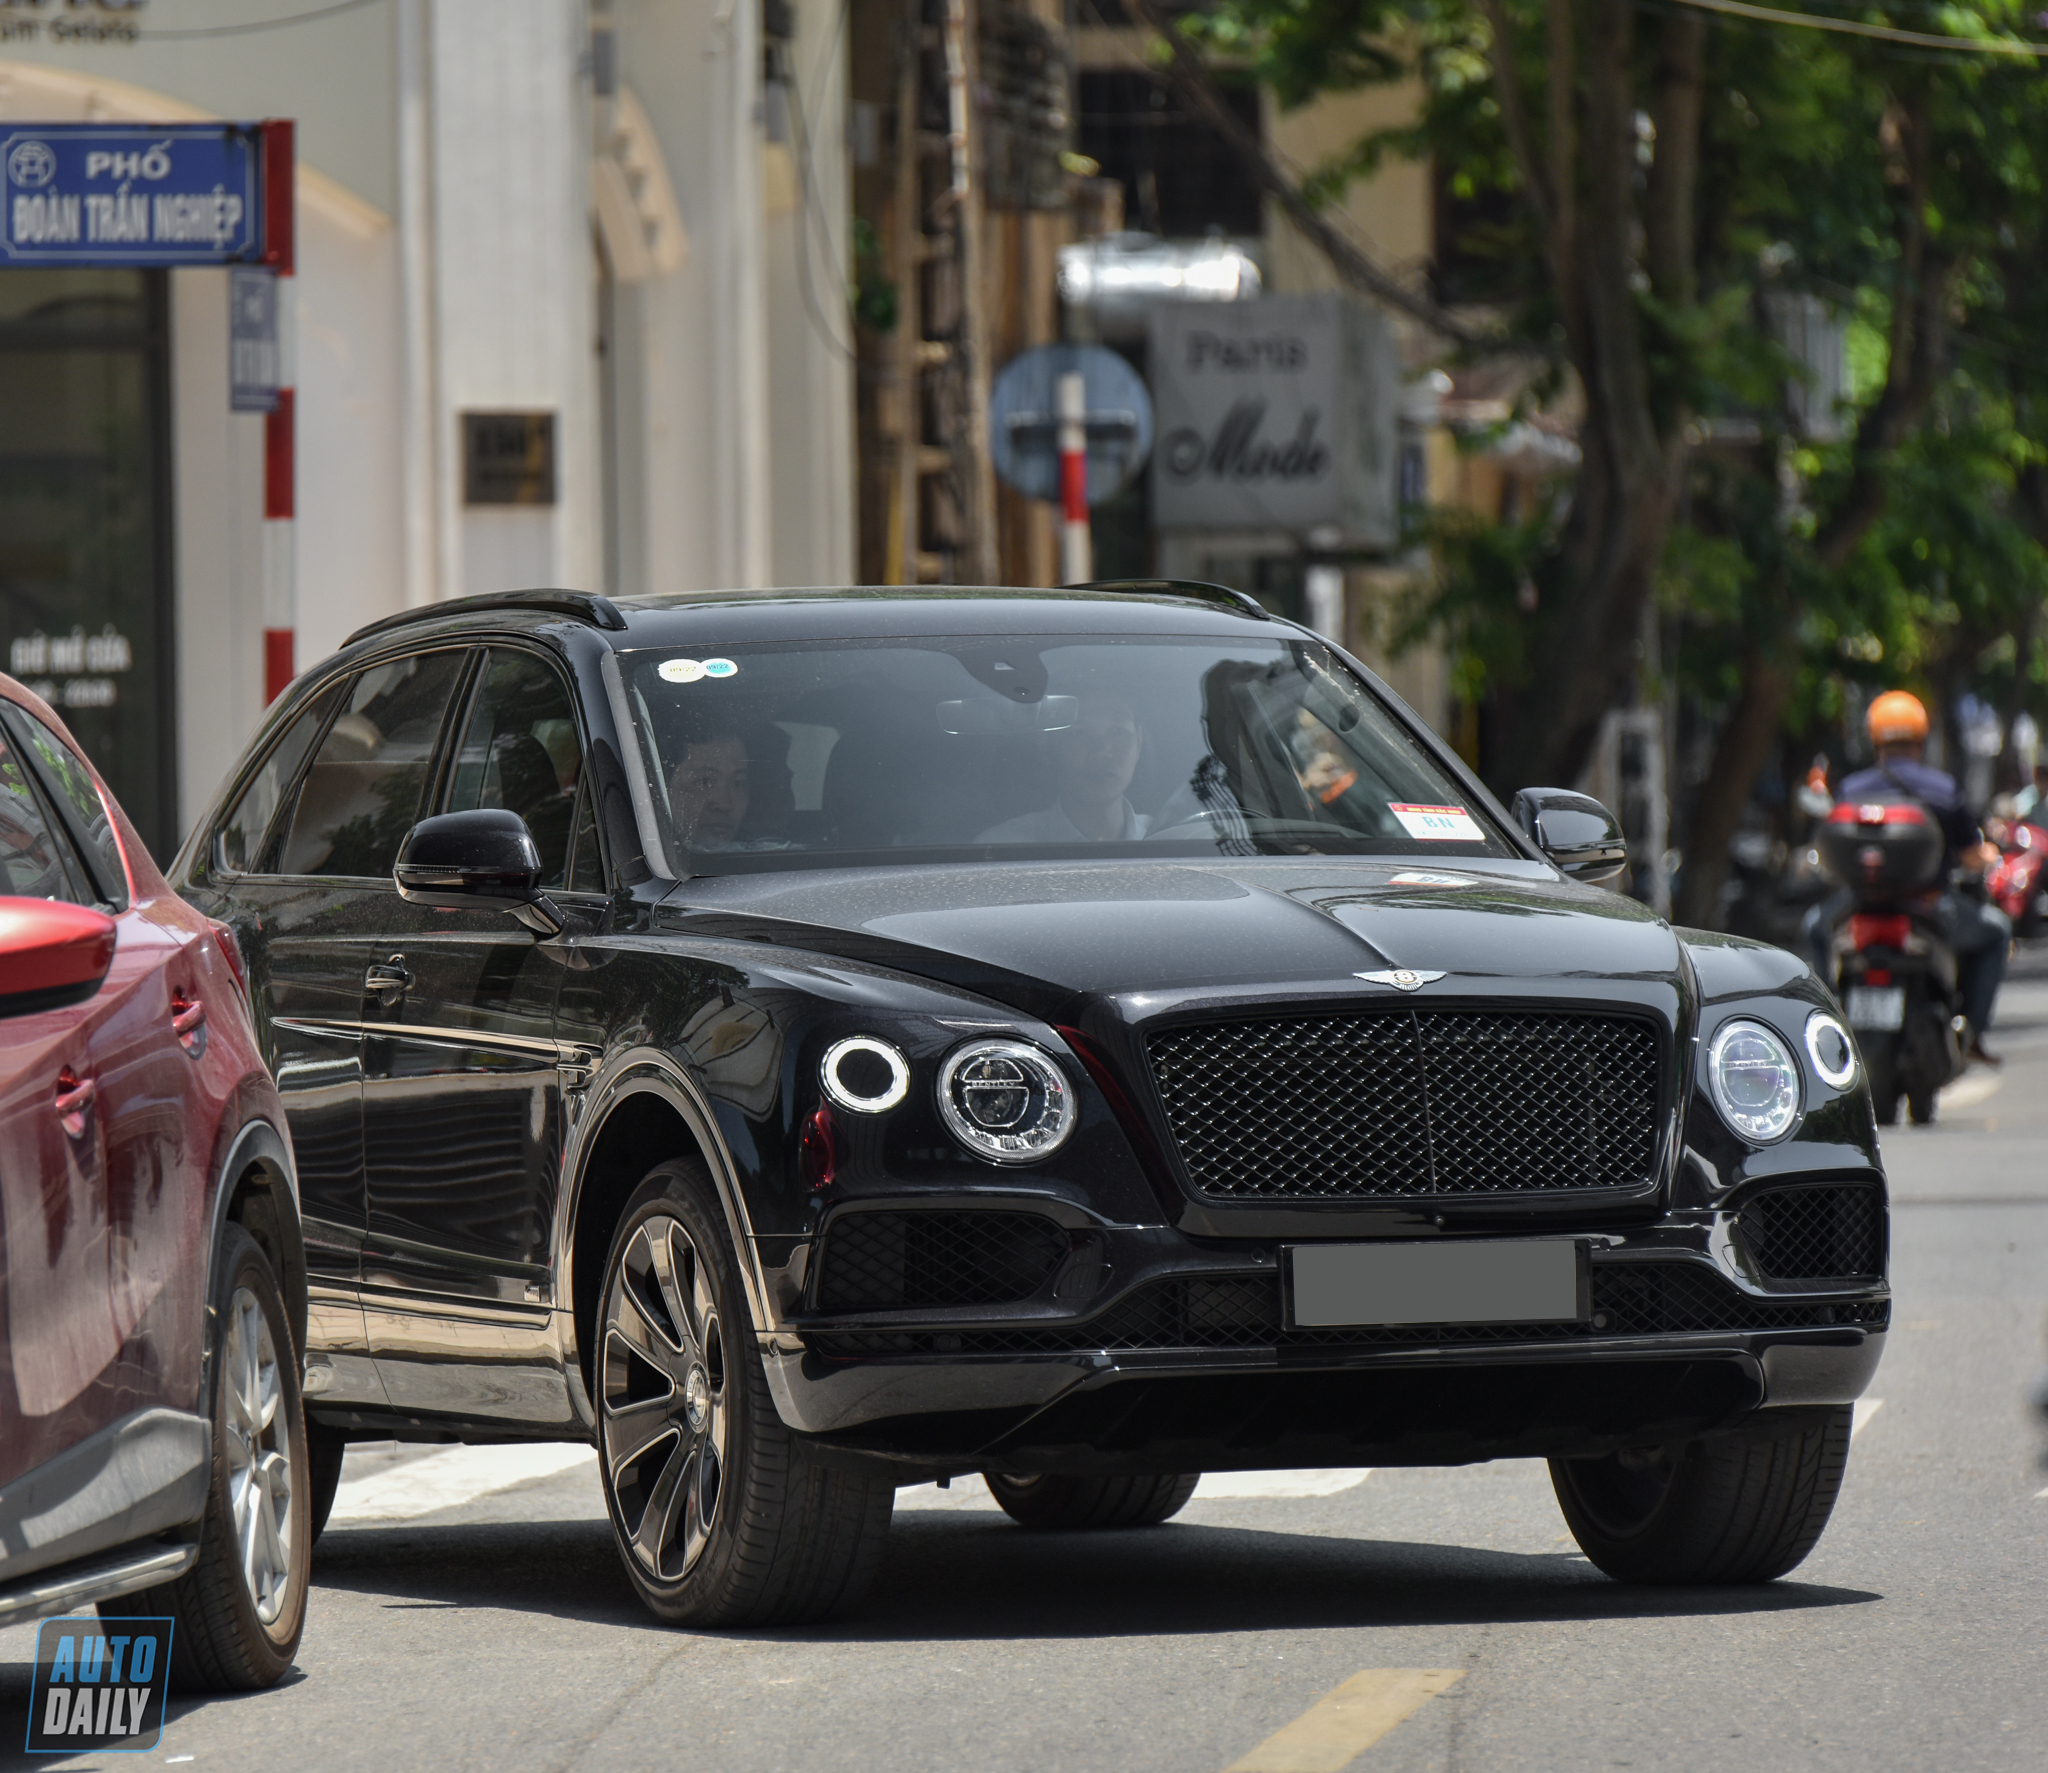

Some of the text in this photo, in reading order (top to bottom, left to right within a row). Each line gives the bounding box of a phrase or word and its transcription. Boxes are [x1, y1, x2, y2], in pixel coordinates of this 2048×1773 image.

[86, 138, 174, 180] PHỐ
[153, 183, 244, 250] NGHIỆP
[1186, 330, 1308, 375] Paris
[1163, 397, 1331, 485] Mode
[1422, 816, 1455, 829] BN
